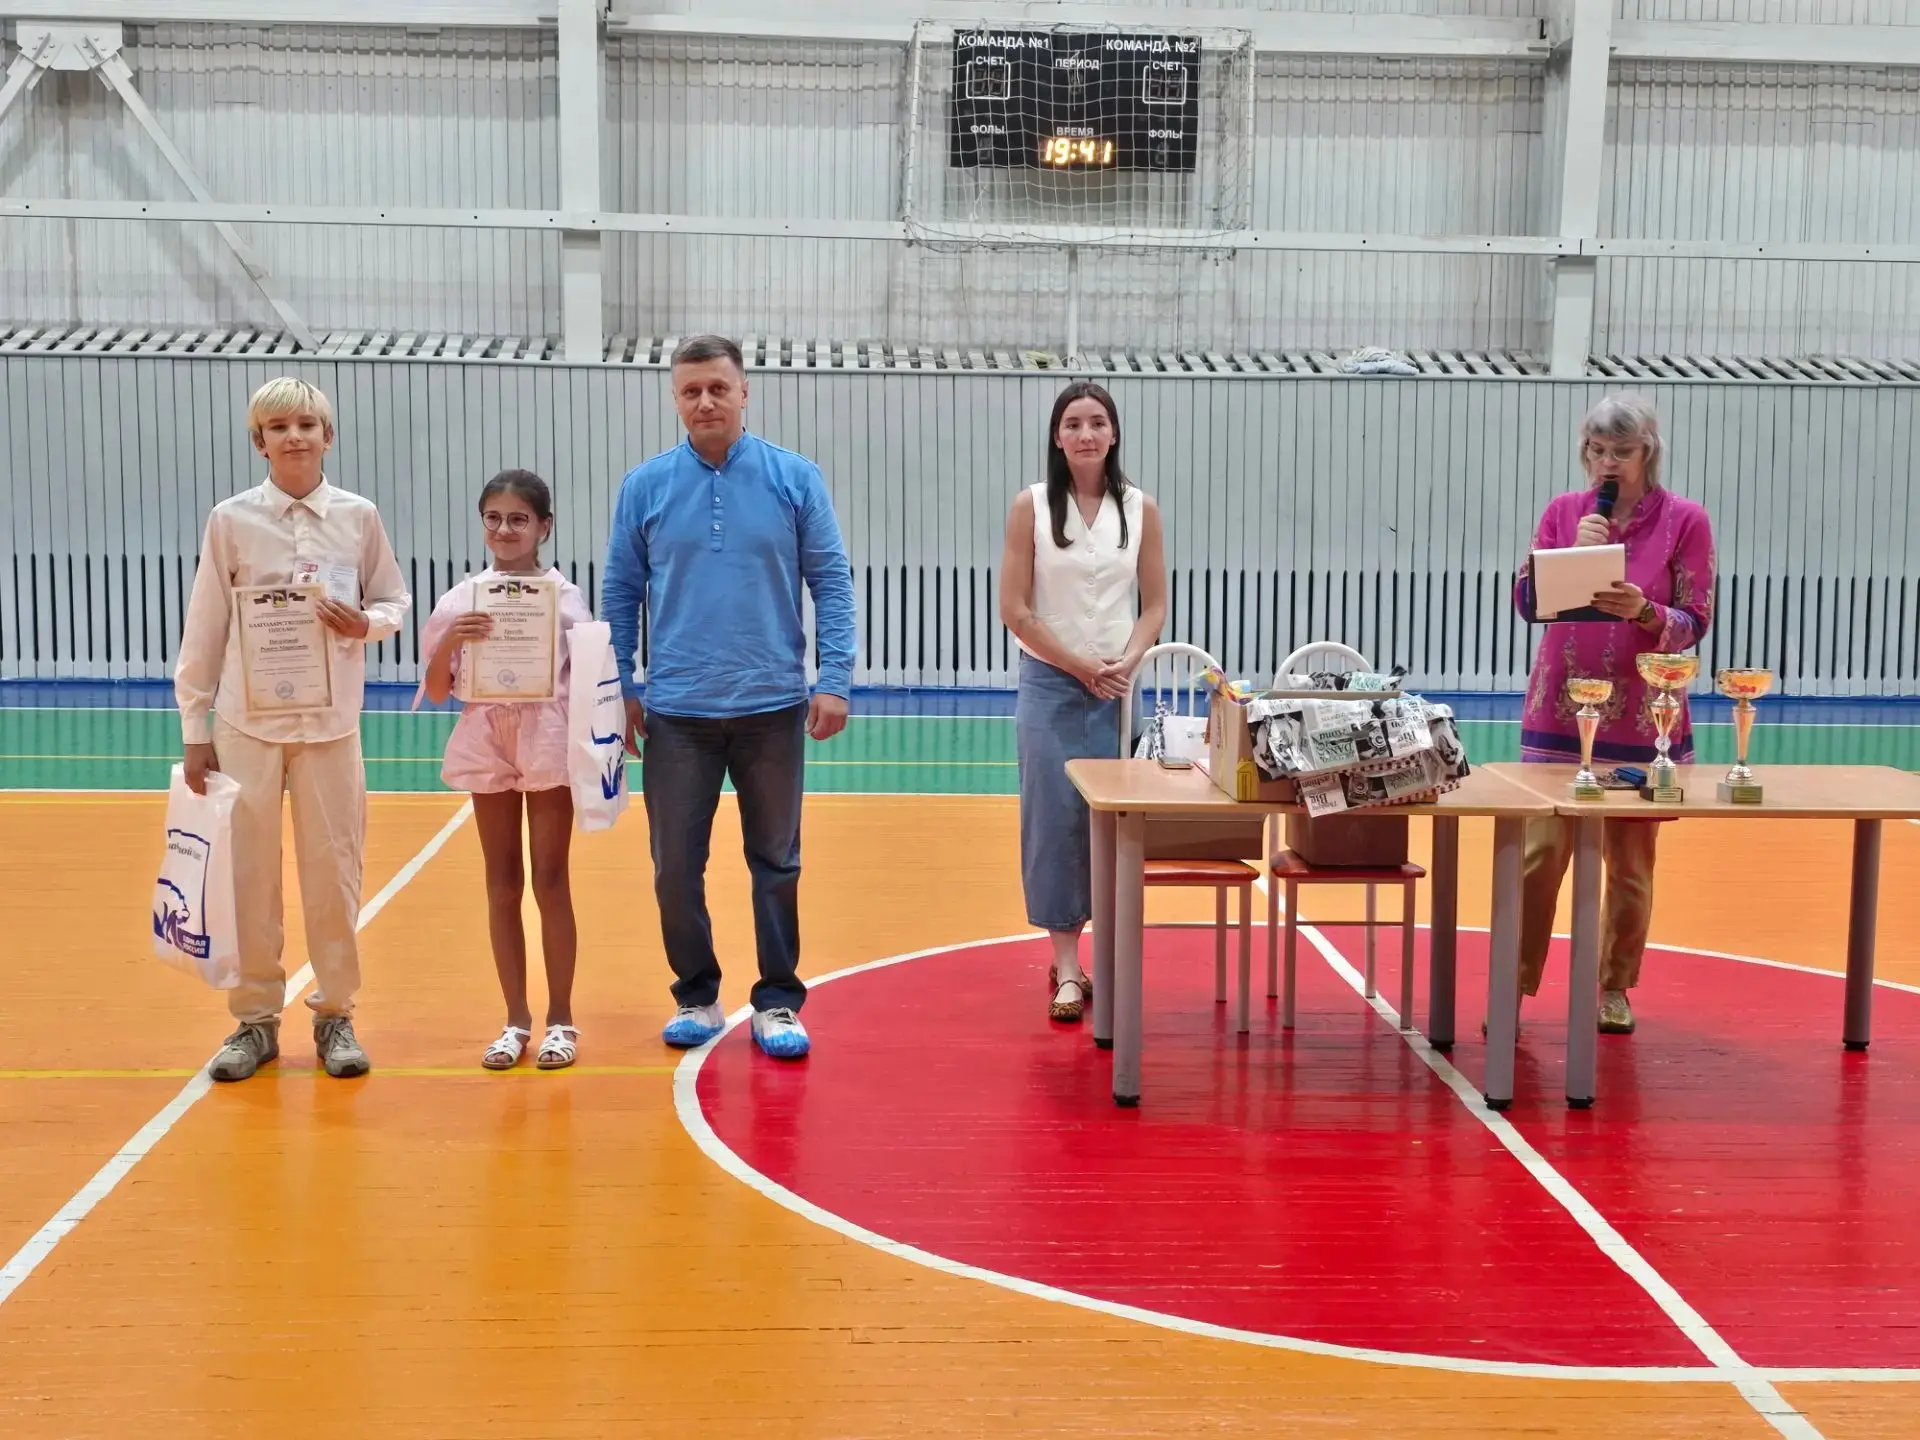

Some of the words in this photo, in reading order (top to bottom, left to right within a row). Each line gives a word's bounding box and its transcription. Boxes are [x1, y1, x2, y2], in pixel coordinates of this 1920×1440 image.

[959, 34, 1024, 50] КОМАНДА
[1028, 37, 1049, 50] №1
[1106, 39, 1171, 53] КОМАНДА
[1175, 41, 1197, 54] №2
[975, 55, 1004, 66] СЧЕТ
[1055, 58, 1100, 71] ПЕРИОД
[1152, 60, 1181, 71] СЧЕТ
[970, 124, 1005, 135] ФОЛЫ
[1056, 126, 1094, 137] ВРЕМЯ
[1149, 129, 1183, 140] ФОЛЫ
[1044, 138, 1112, 164] 19:41
